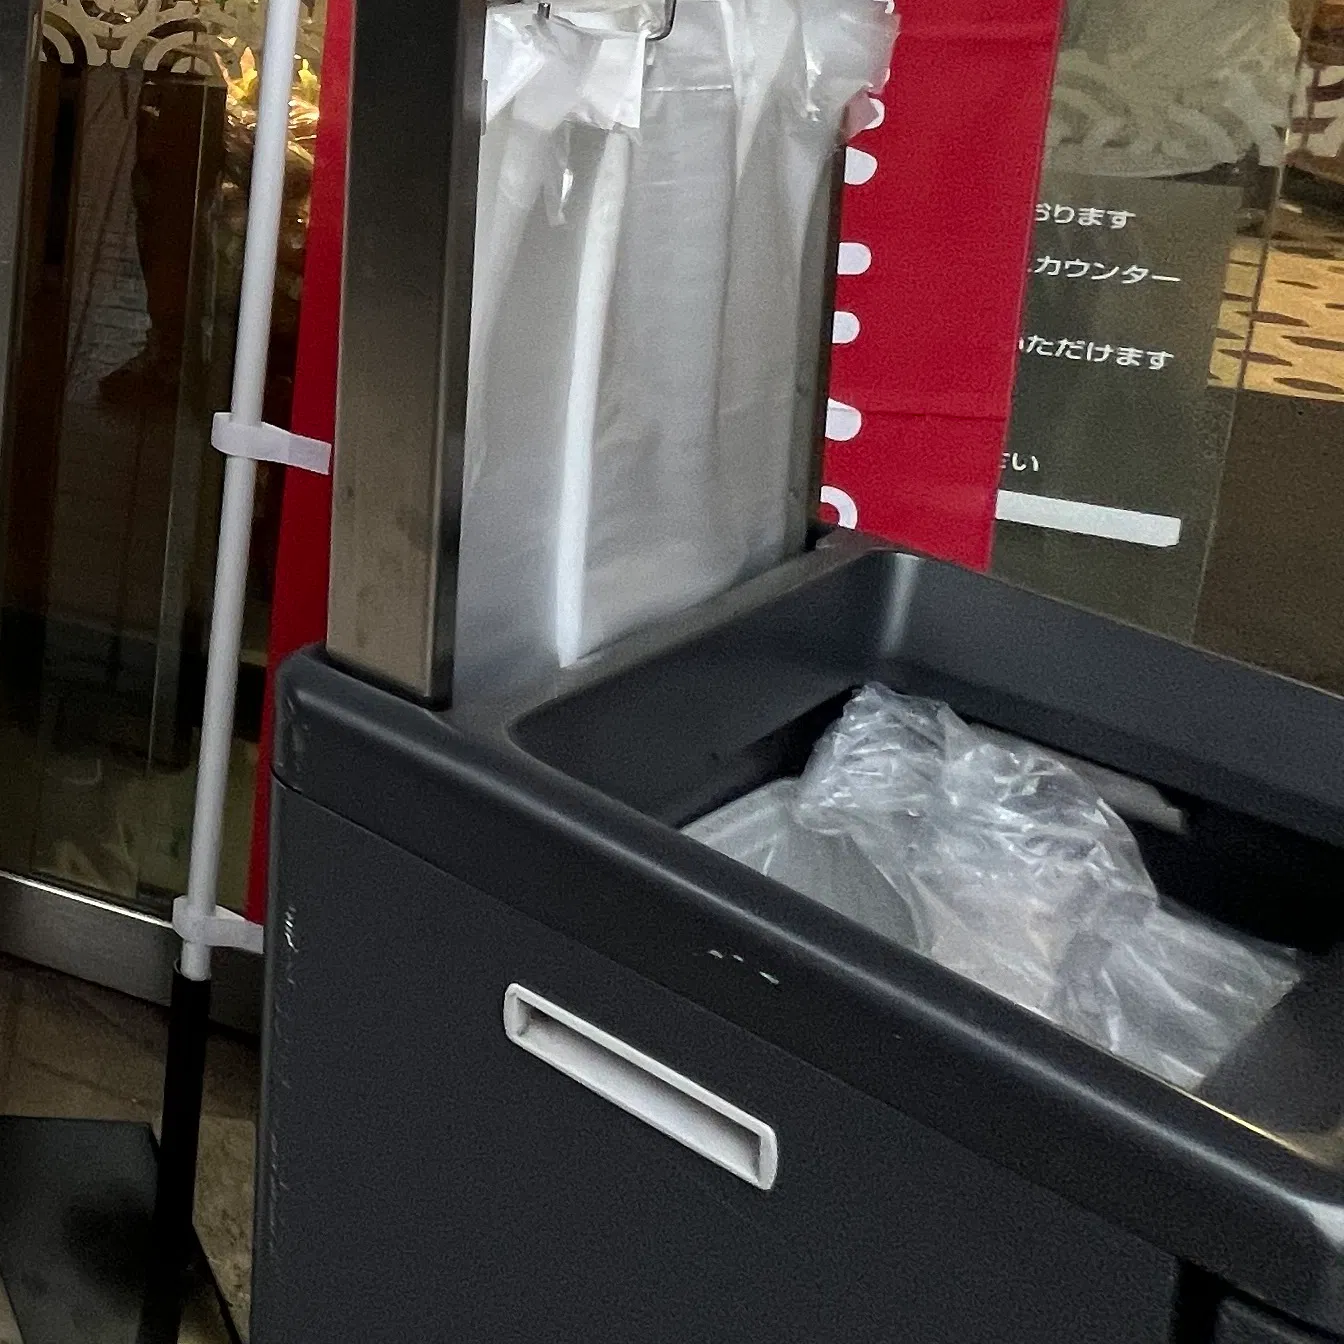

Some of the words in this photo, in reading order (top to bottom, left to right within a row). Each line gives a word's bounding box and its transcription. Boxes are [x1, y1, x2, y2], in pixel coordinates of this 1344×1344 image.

[1027, 255, 1181, 284] カウンター
